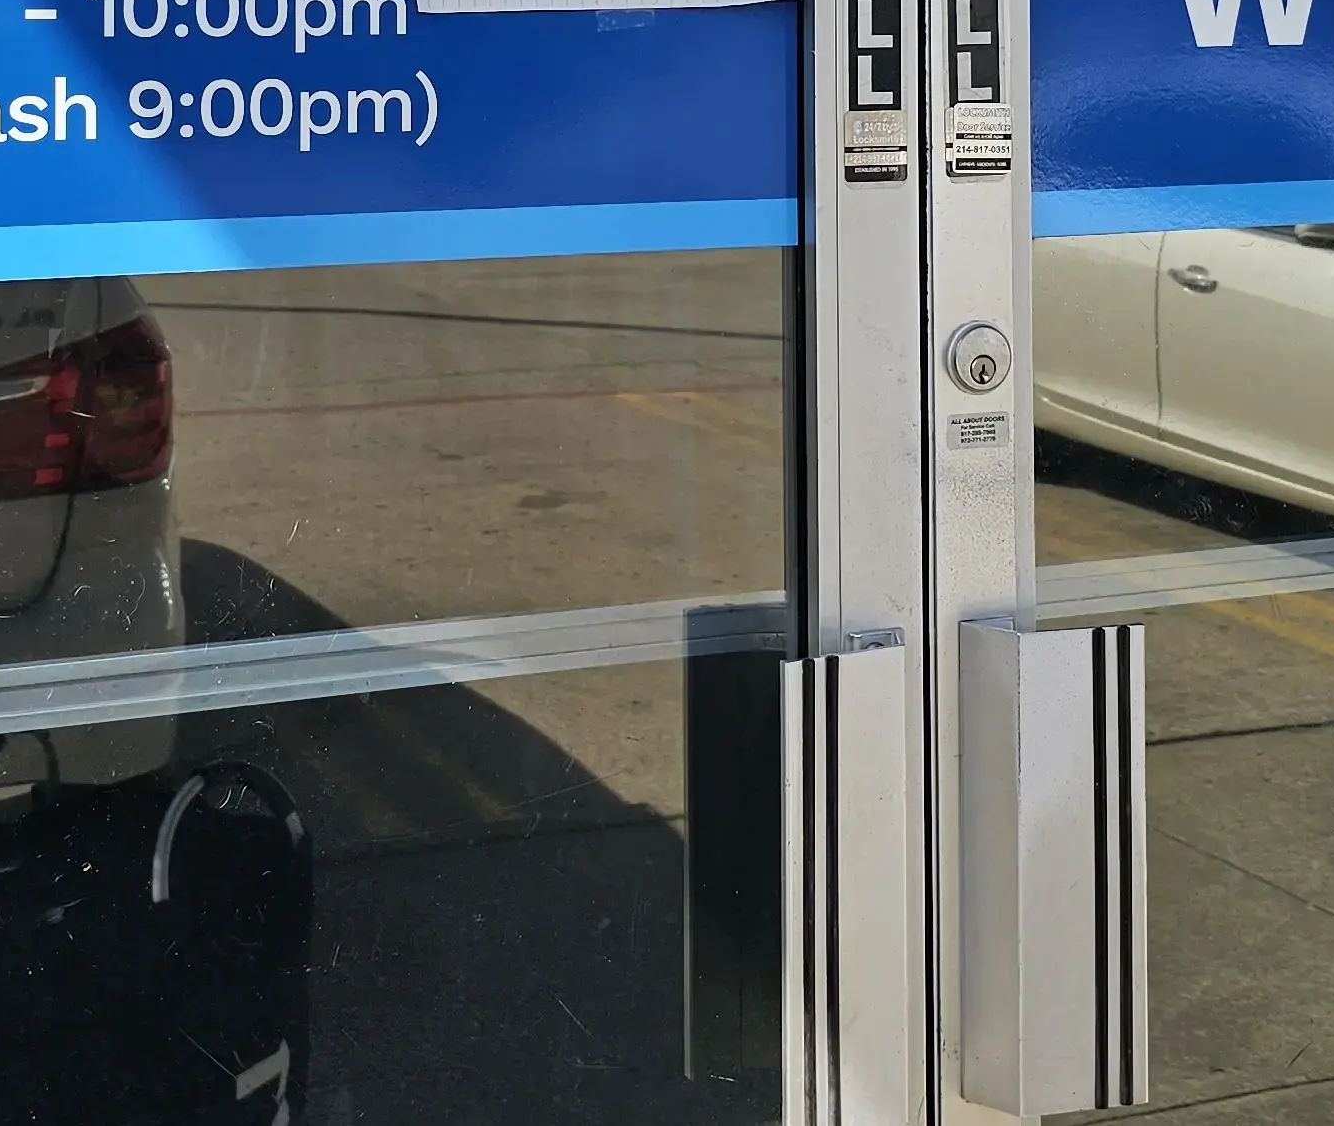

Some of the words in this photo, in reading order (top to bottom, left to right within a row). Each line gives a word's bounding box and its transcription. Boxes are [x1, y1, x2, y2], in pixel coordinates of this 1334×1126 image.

[24, 10, 58, 21] -
[129, 70, 439, 152] 9:00pm)
[957, 107, 1010, 117] LOCKSMITH
[956, 145, 1010, 154] 214-817-0351
